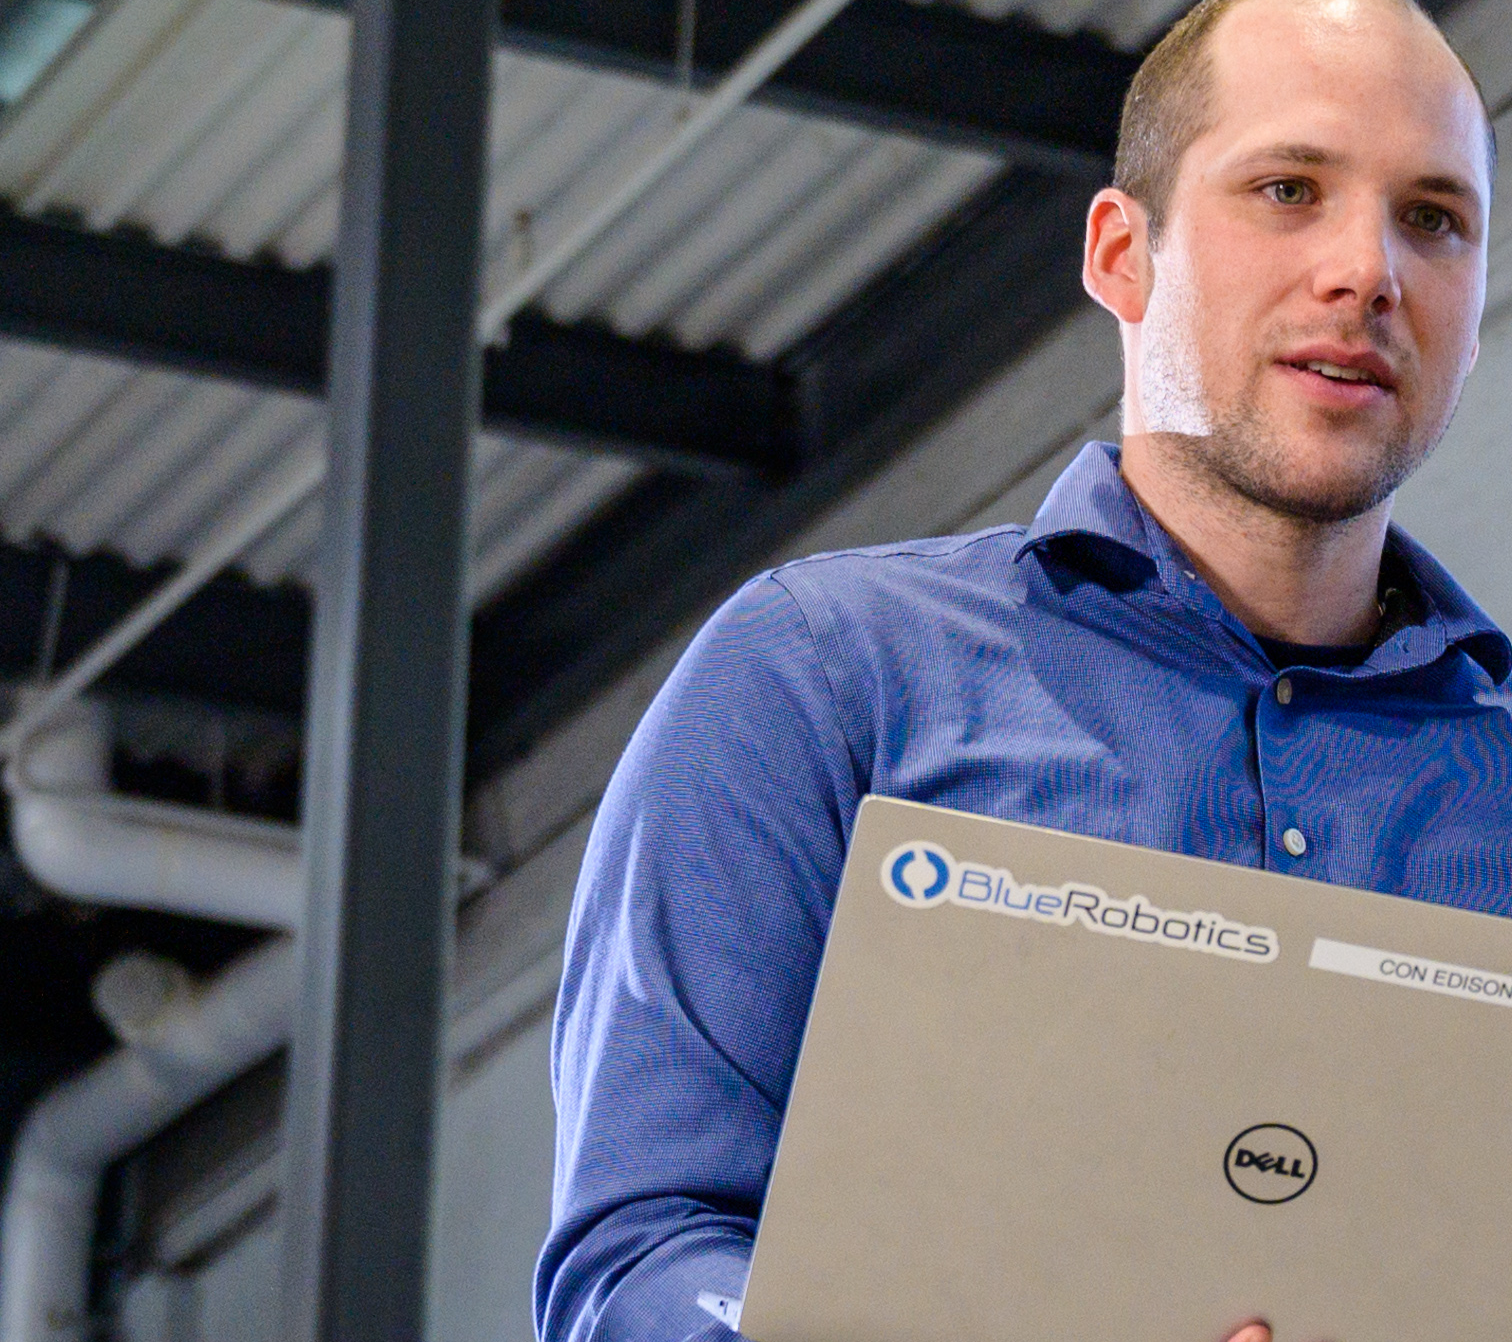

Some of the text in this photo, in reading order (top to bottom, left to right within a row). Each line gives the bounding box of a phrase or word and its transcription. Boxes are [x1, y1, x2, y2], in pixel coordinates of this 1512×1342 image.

[957, 870, 1272, 958] BlueRobotics
[1379, 958, 1430, 984] CON
[1234, 1148, 1306, 1179] DELL
